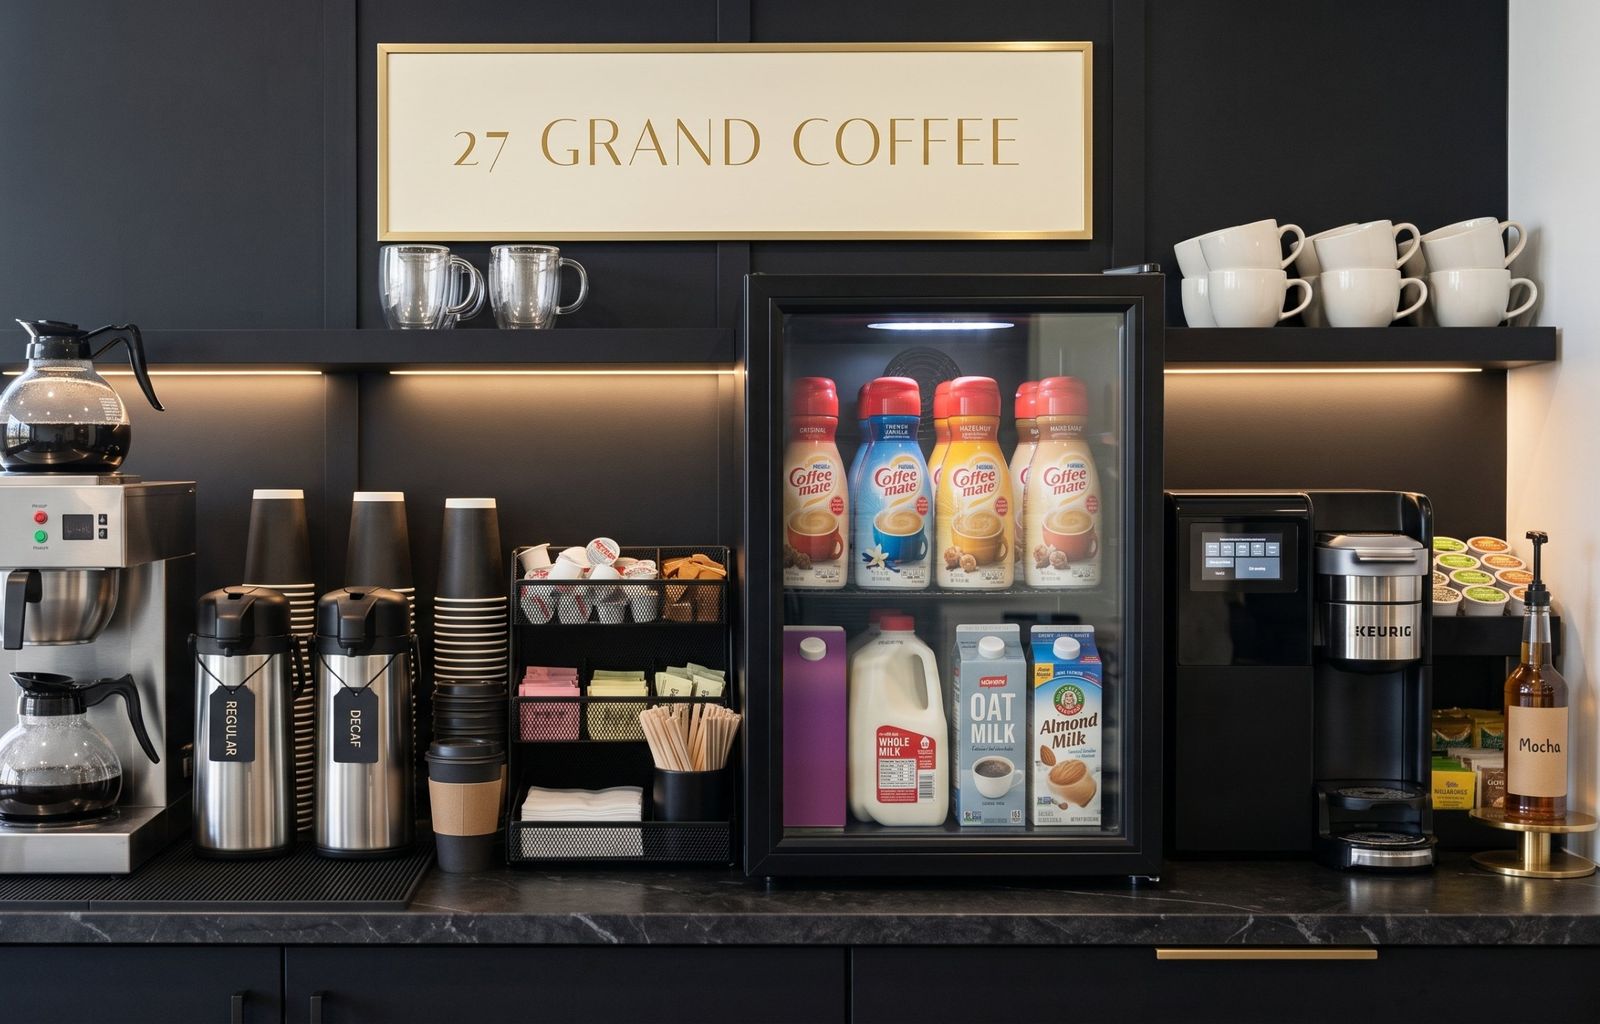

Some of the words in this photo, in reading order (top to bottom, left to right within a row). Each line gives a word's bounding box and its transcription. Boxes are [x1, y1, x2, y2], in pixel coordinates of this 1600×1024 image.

[453, 131, 510, 173] 27
[541, 118, 761, 167] GRAND
[793, 118, 1020, 167] COFFEE
[789, 467, 832, 488] Coffee
[874, 467, 918, 488] Coffee
[953, 468, 996, 488] Coffee
[1043, 467, 1087, 487] Coffee
[799, 480, 832, 497] mate
[884, 481, 917, 497] mate
[962, 482, 995, 497] mate
[1053, 480, 1086, 496] mate
[1355, 625, 1412, 638] KEURIG
[970, 692, 1016, 722] OAT
[225, 700, 237, 756] REGULAR
[349, 709, 361, 749] DECAF
[971, 723, 1016, 744] MILK
[1040, 712, 1098, 735] Almond
[878, 737, 910, 747] WHOLE
[1052, 731, 1086, 749] Milk
[1519, 737, 1562, 754] Mocha
[878, 747, 901, 757] MILK
